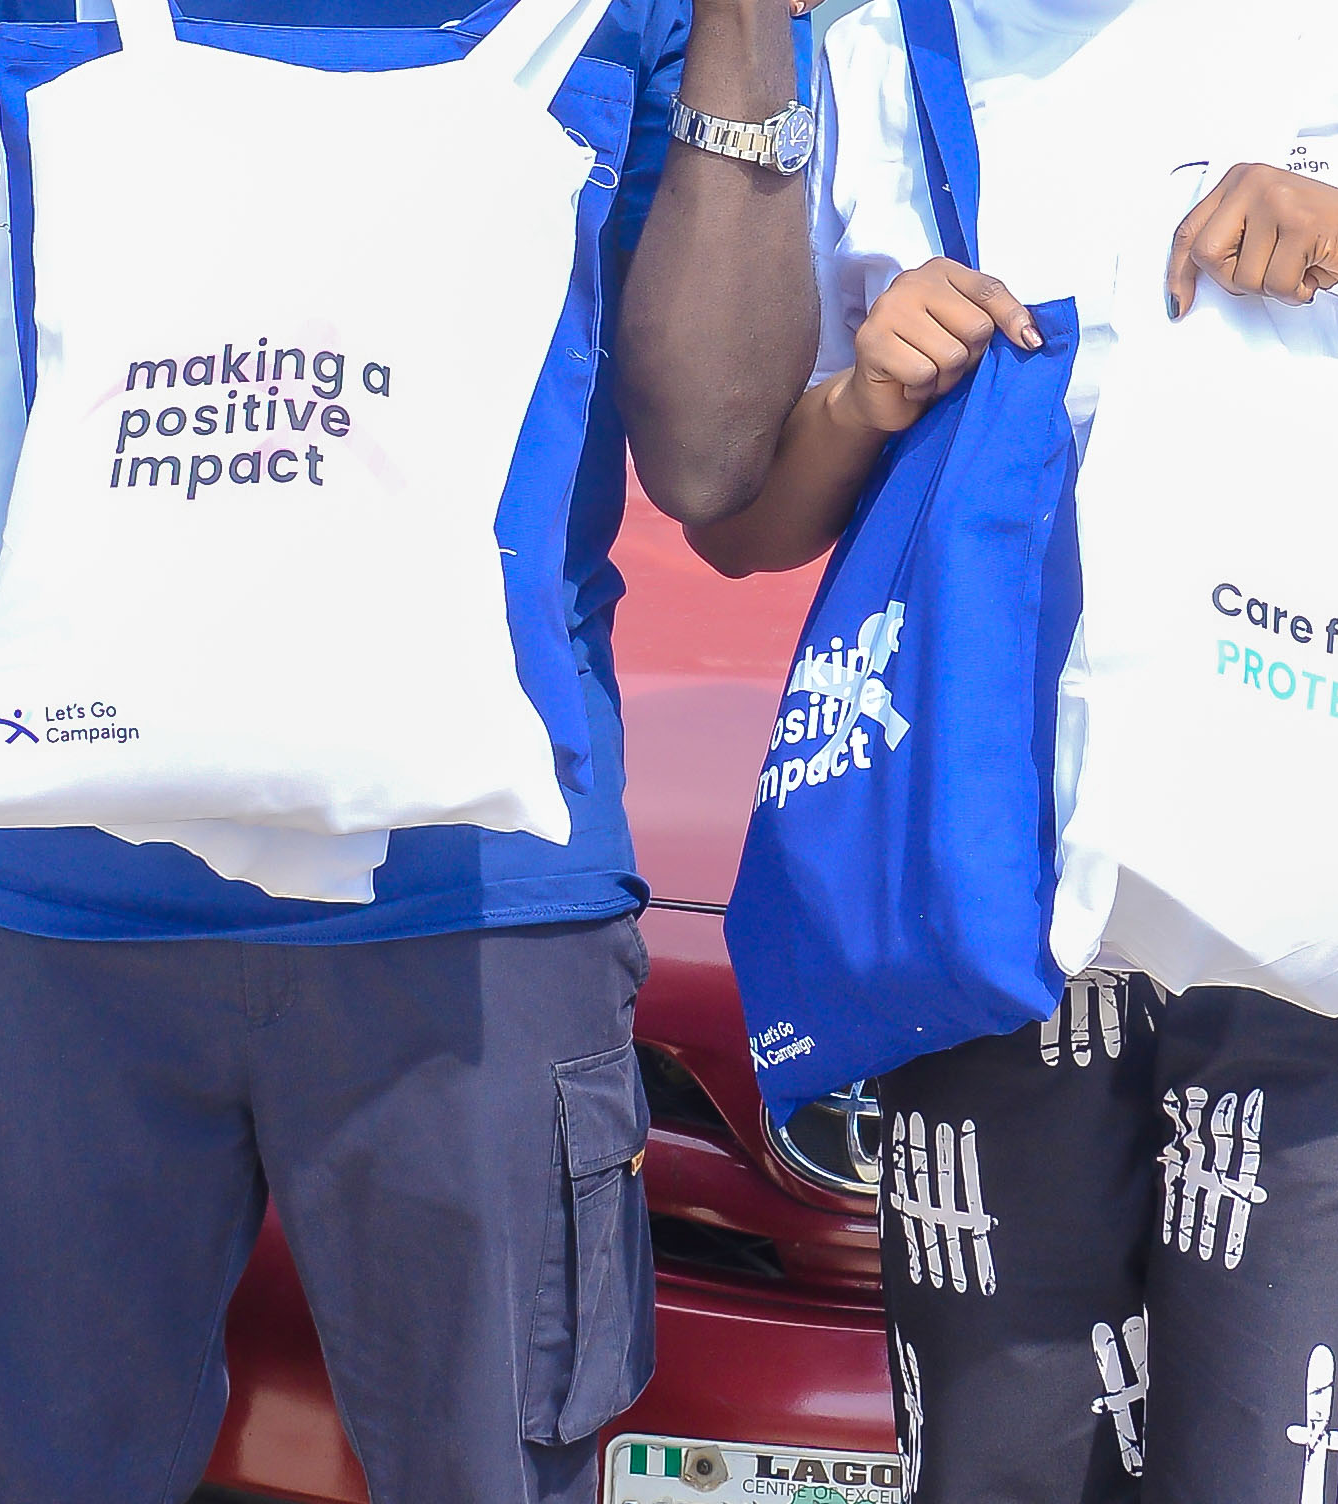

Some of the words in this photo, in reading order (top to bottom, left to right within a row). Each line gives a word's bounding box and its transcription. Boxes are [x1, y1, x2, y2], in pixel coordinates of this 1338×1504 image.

[125, 337, 345, 400] making
[362, 359, 392, 397] a
[116, 389, 351, 453] positive
[110, 444, 325, 500] impact
[1211, 582, 1314, 645] Care
[45, 703, 86, 722] Let's
[90, 701, 117, 719] Go
[45, 723, 140, 744] Campaign
[755, 726, 872, 811] mpact
[758, 1025, 781, 1048] Let's
[777, 1021, 795, 1037] Go
[766, 1035, 816, 1065] Campaign
[742, 1478, 806, 1497] CENTRE
[813, 1485, 839, 1501] OF
